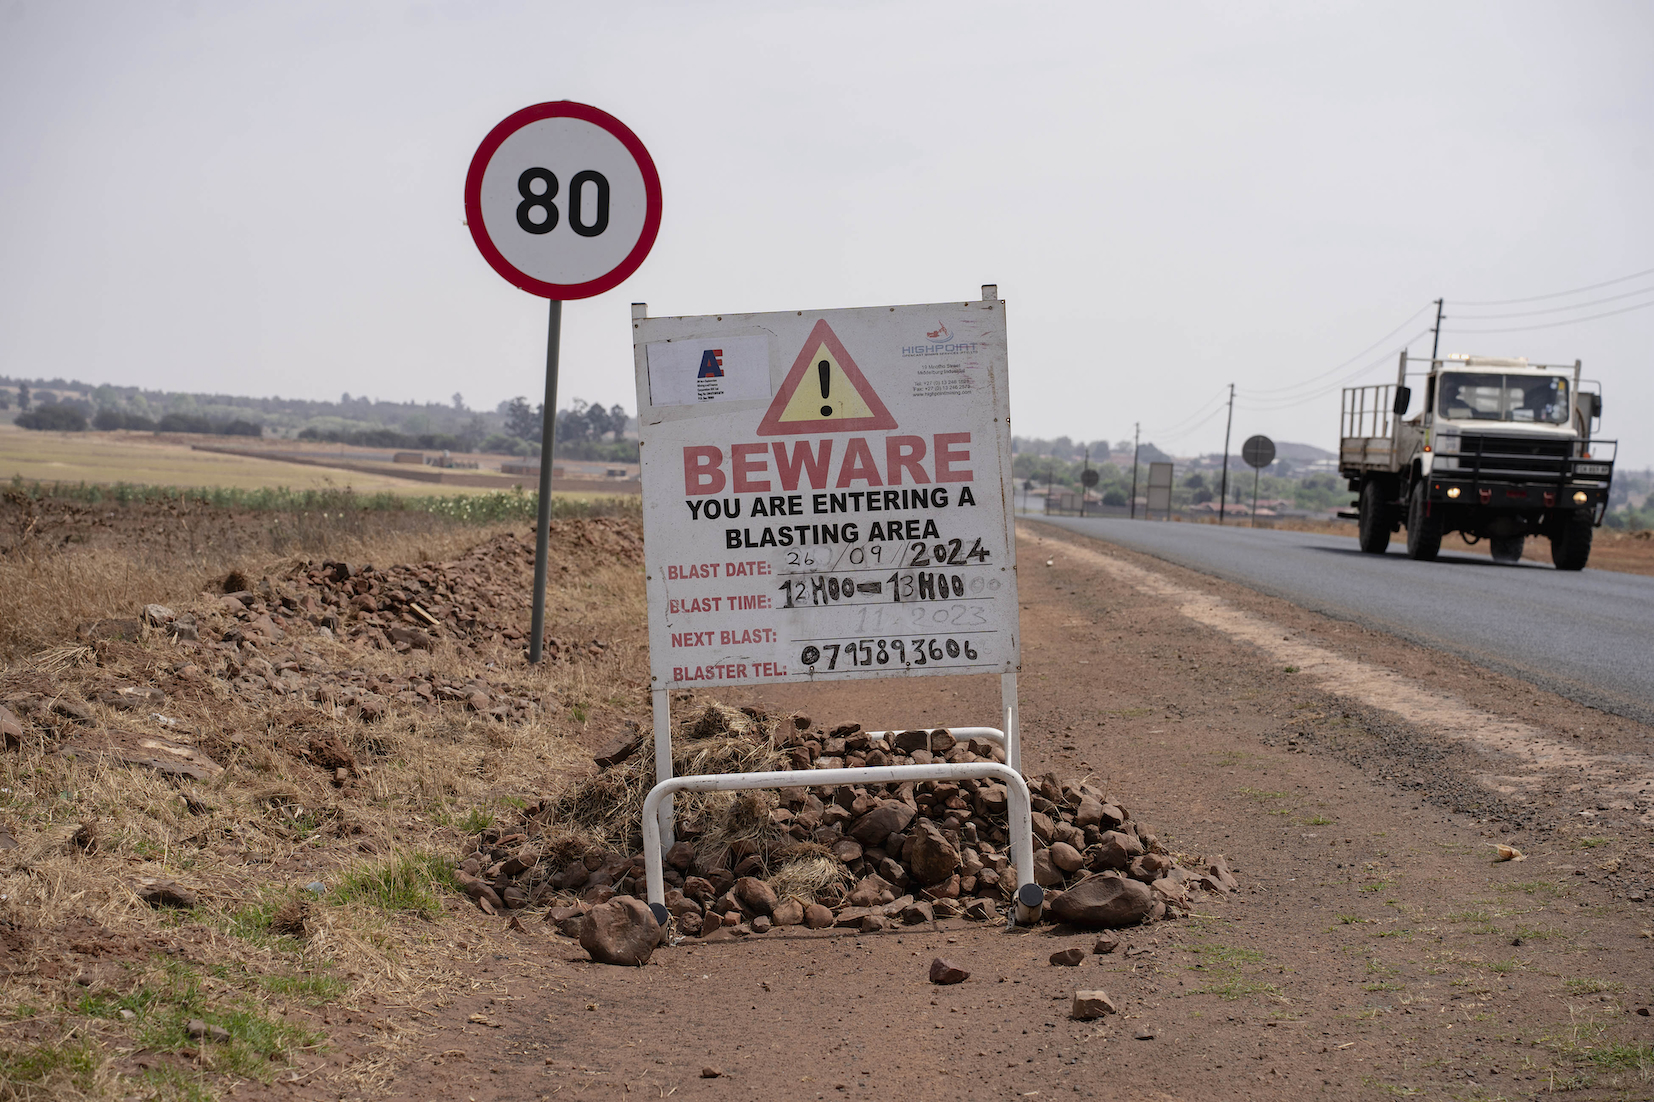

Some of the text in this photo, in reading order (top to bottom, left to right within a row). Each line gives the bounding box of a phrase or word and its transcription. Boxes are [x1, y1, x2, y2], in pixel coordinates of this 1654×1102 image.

[516, 166, 610, 237] 80
[902, 342, 978, 354] HIGHPOINT
[683, 432, 974, 496] BEWARE
[686, 486, 976, 520] YOU ARE ENTERING A
[725, 519, 940, 549] BLASTING AREA
[668, 560, 772, 580] BLAST DATE:
[669, 594, 772, 614] BLAST TIME:
[671, 628, 777, 648] NEXT BLAST:
[673, 662, 788, 682] BLASTER TEL:
